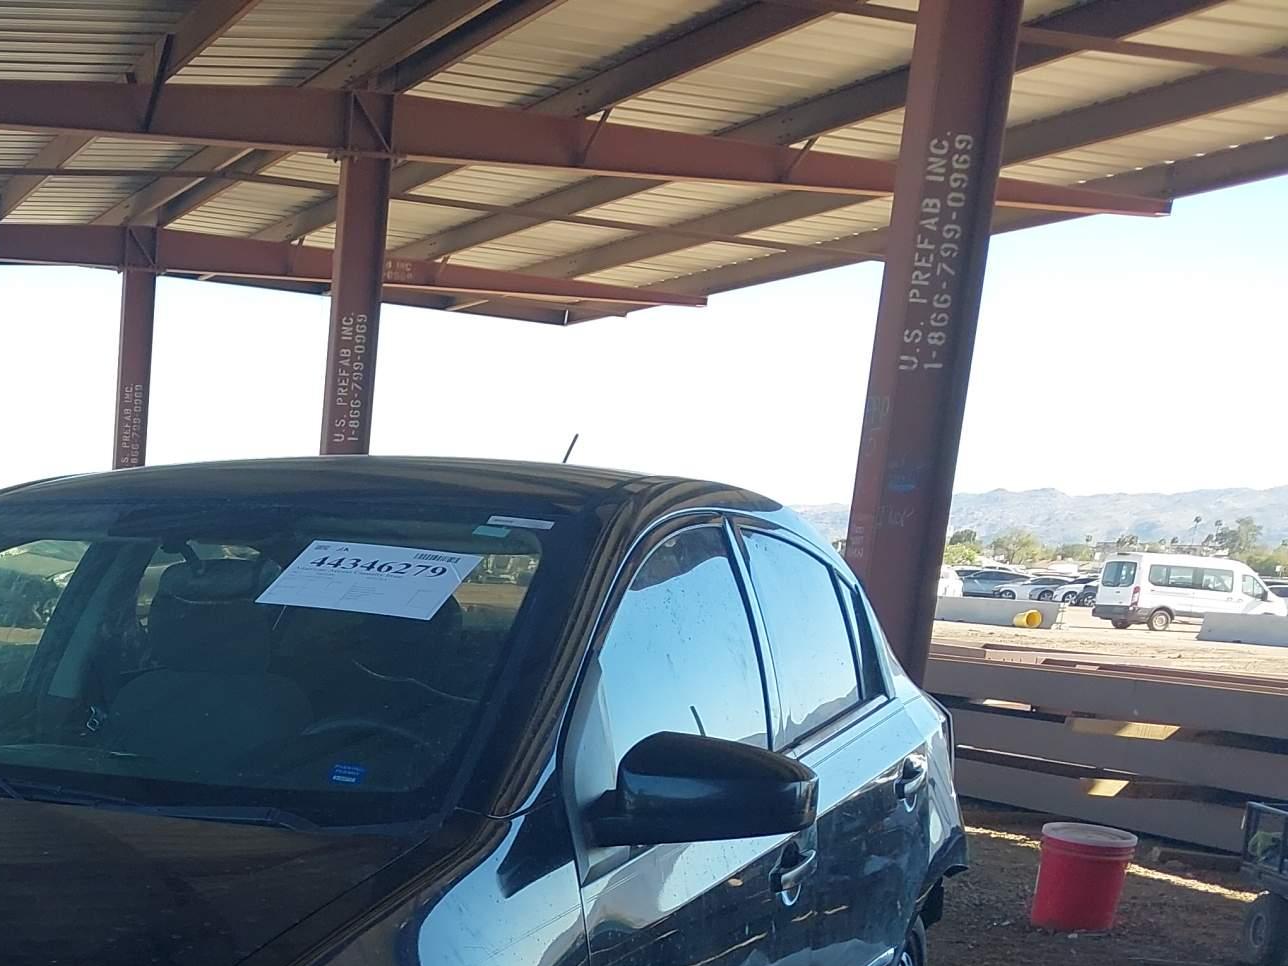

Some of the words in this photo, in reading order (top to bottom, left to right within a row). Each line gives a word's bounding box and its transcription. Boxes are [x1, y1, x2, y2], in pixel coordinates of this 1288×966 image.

[925, 131, 952, 182] INC.
[909, 197, 941, 303] PREFAB
[923, 134, 973, 369] 1-866-799-0969
[341, 312, 355, 341] INC.
[899, 321, 924, 371] U.S.
[336, 348, 352, 406] PREFAB
[347, 314, 368, 441] 1-866-799-0969
[332, 414, 346, 442] U.S.
[310, 556, 449, 578] 44346279
